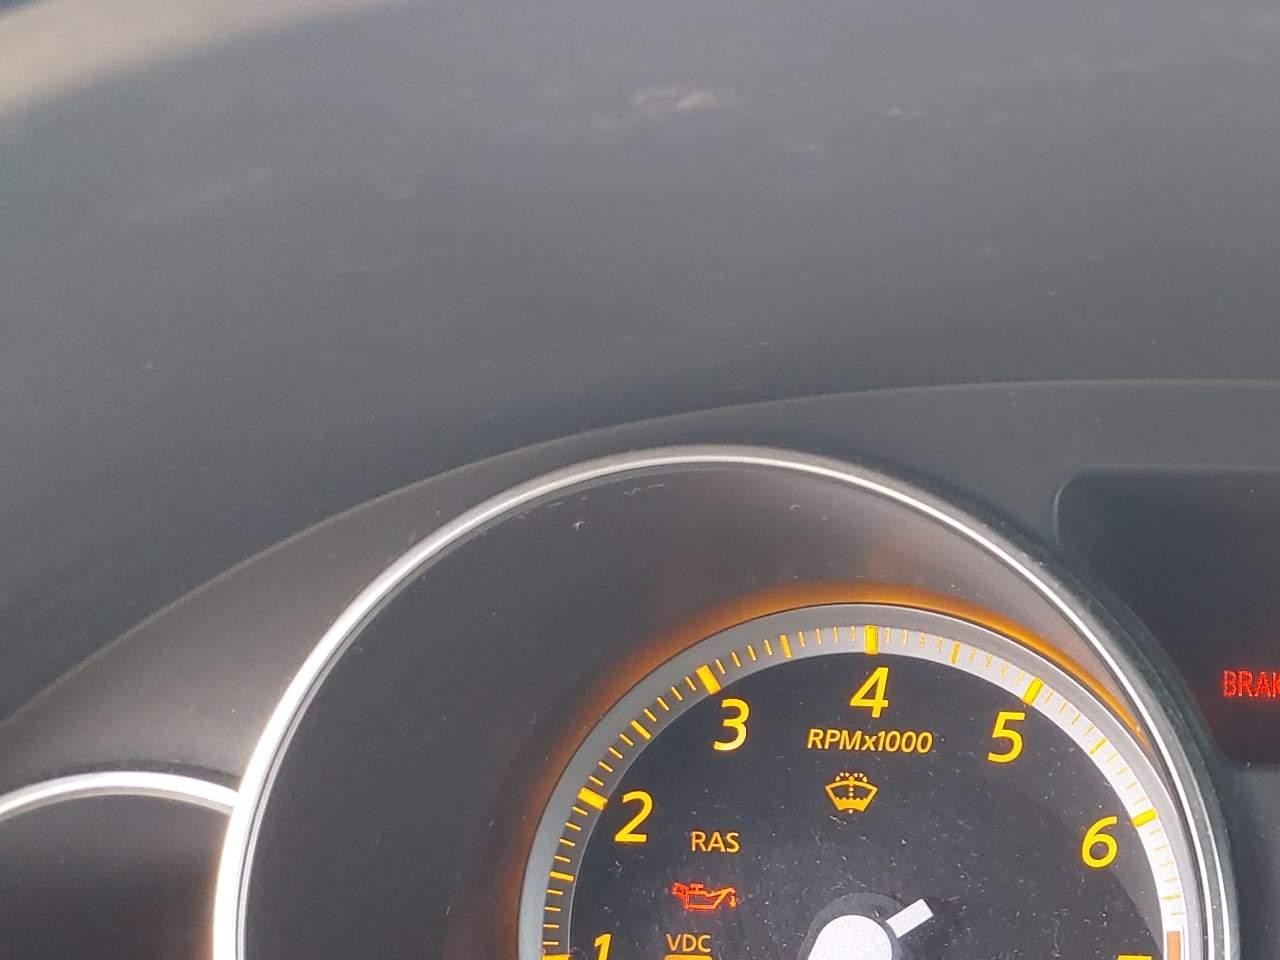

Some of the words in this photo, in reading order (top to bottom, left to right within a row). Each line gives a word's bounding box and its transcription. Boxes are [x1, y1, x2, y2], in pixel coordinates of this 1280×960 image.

[850, 667, 890, 718] 4
[713, 698, 750, 751] 3
[807, 728, 934, 753] RPMx1000
[988, 711, 1026, 763] 5
[614, 790, 654, 843] 2
[690, 831, 741, 853] RAS
[1081, 816, 1119, 868] 6
[666, 933, 711, 953] VDC
